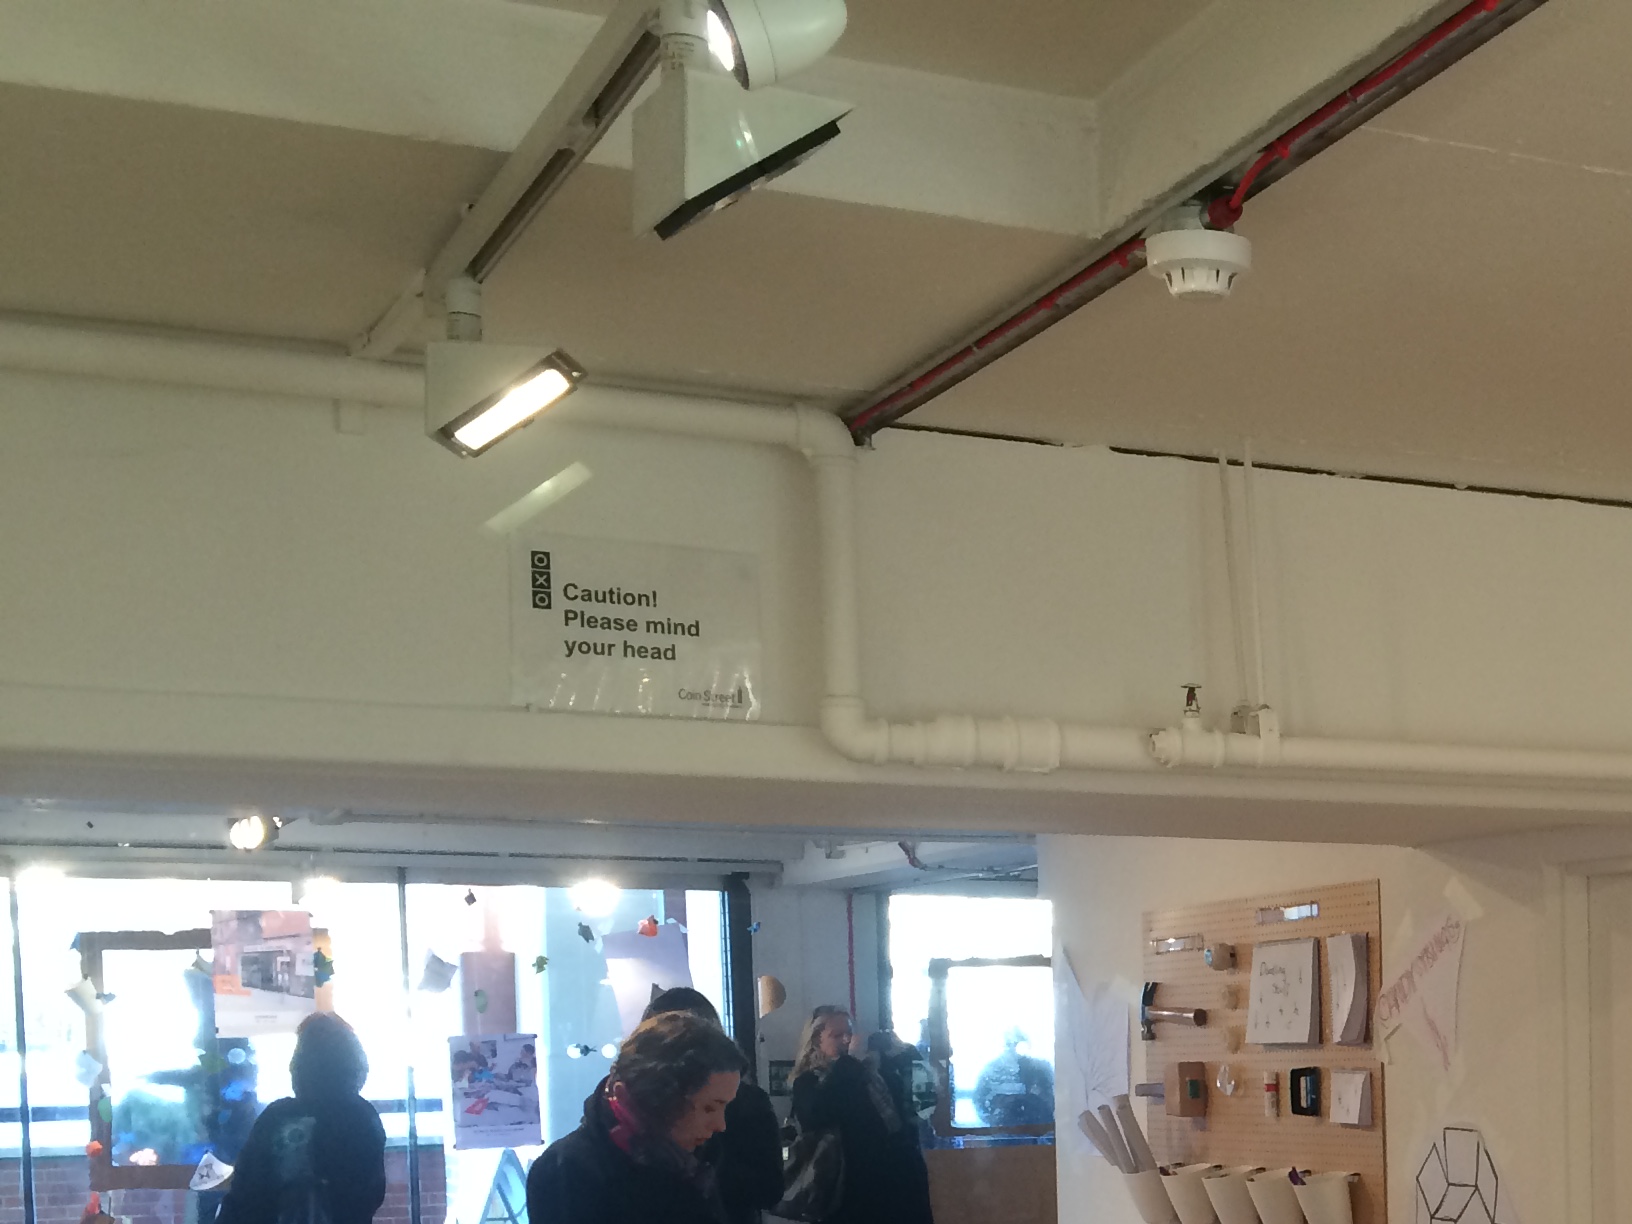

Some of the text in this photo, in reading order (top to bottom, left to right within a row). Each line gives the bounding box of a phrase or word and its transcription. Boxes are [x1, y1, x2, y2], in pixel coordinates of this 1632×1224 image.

[563, 583, 658, 608] Caution!
[564, 609, 700, 637] Please mind
[564, 640, 676, 660] your head
